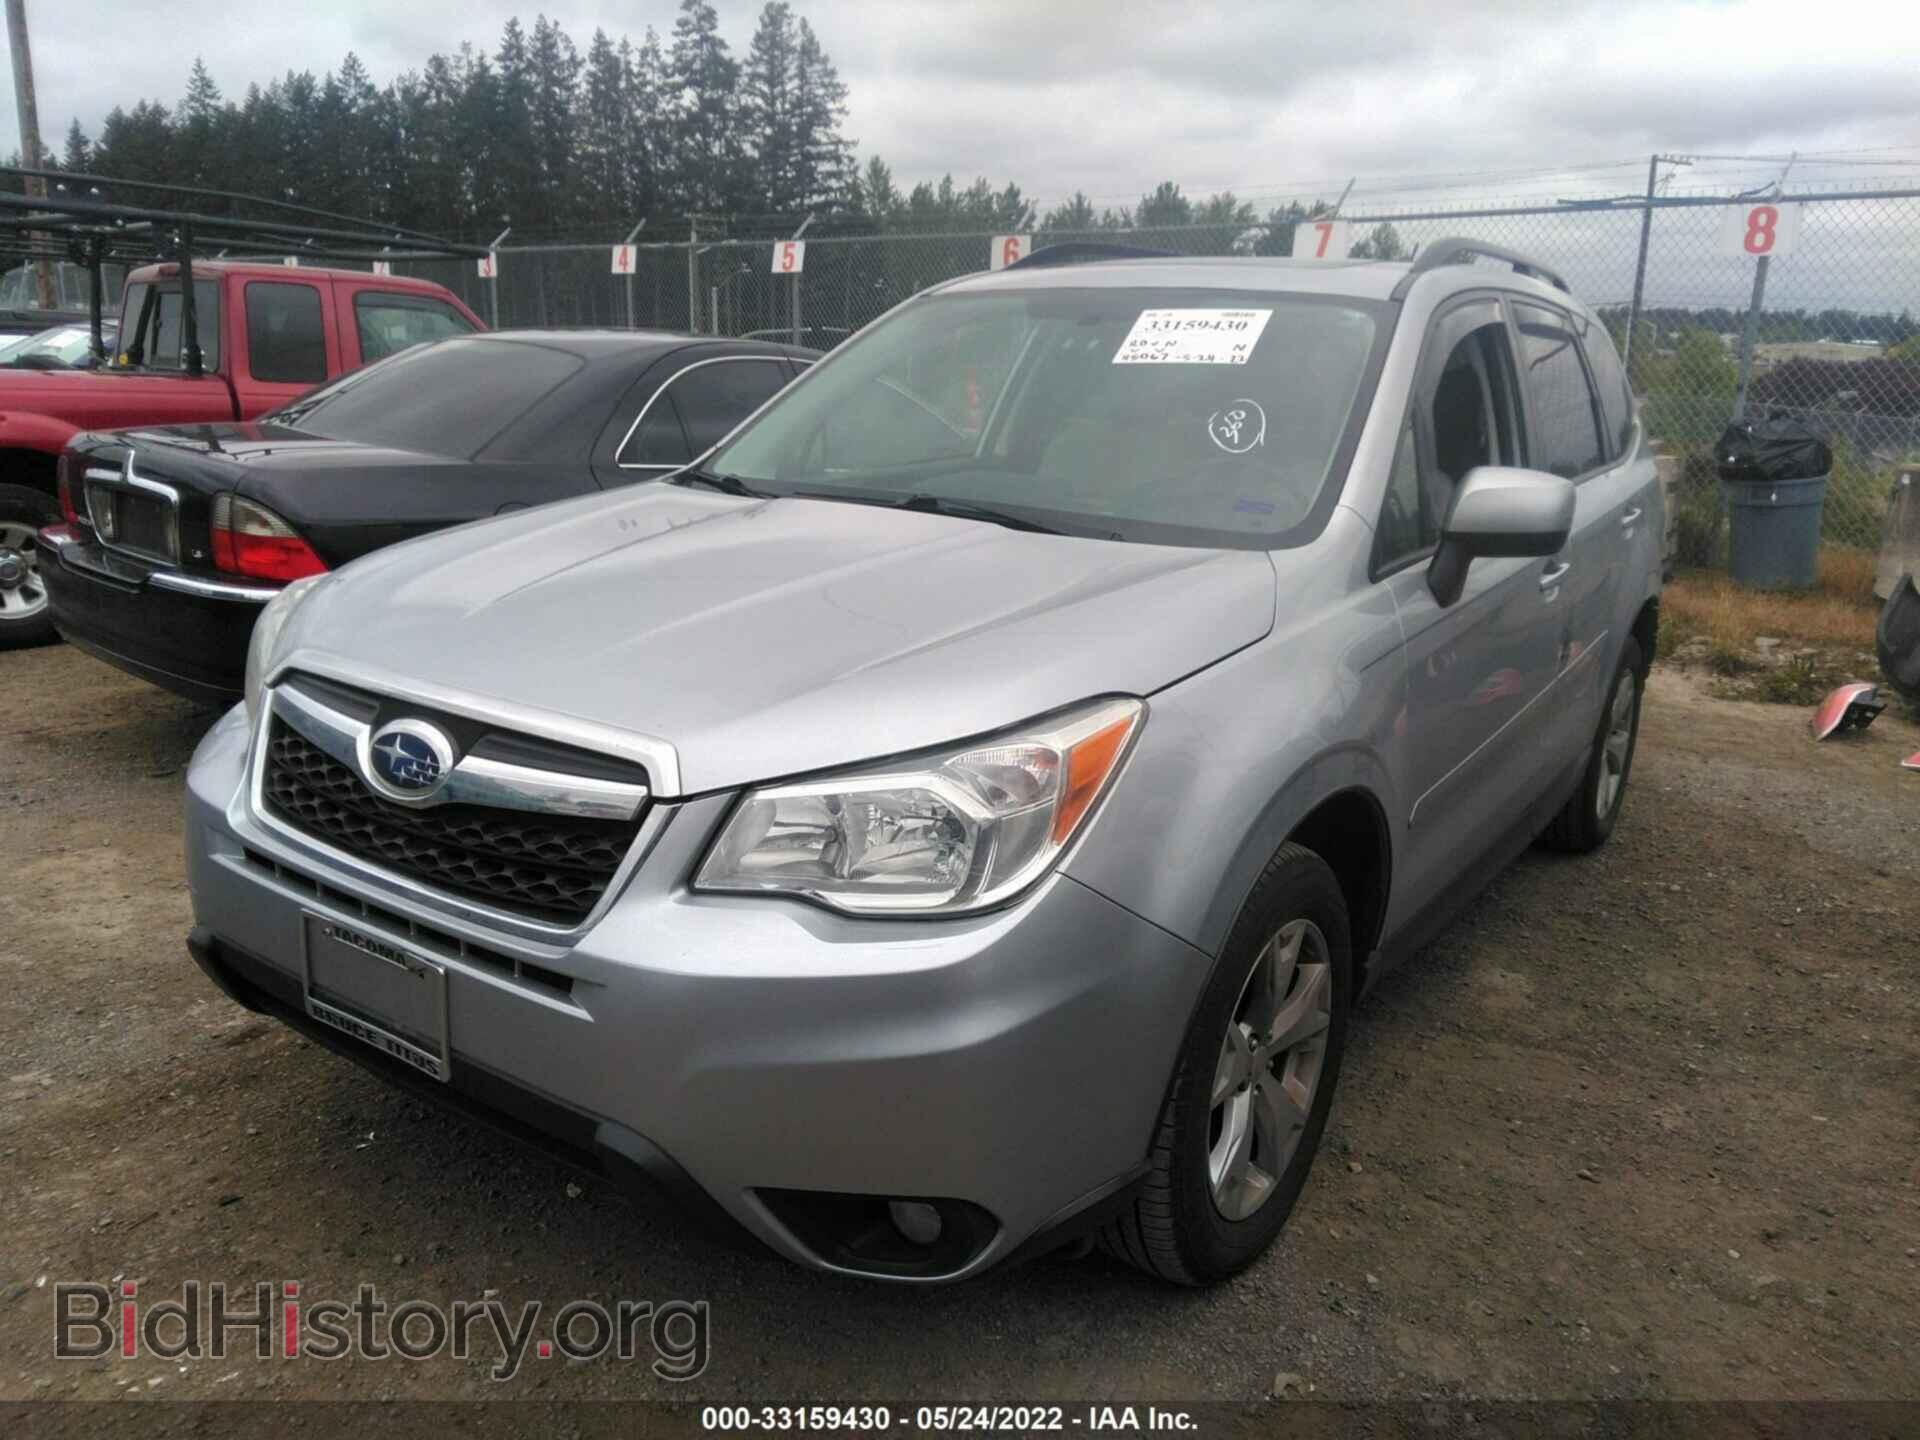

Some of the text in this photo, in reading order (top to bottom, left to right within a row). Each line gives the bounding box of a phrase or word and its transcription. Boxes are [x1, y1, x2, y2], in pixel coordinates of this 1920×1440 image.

[1315, 223, 1334, 257] 7
[1744, 206, 1778, 254] 8
[618, 247, 629, 272] 4
[782, 243, 797, 272] 5
[1003, 237, 1020, 268] 6
[1145, 319, 1249, 333] 33159430
